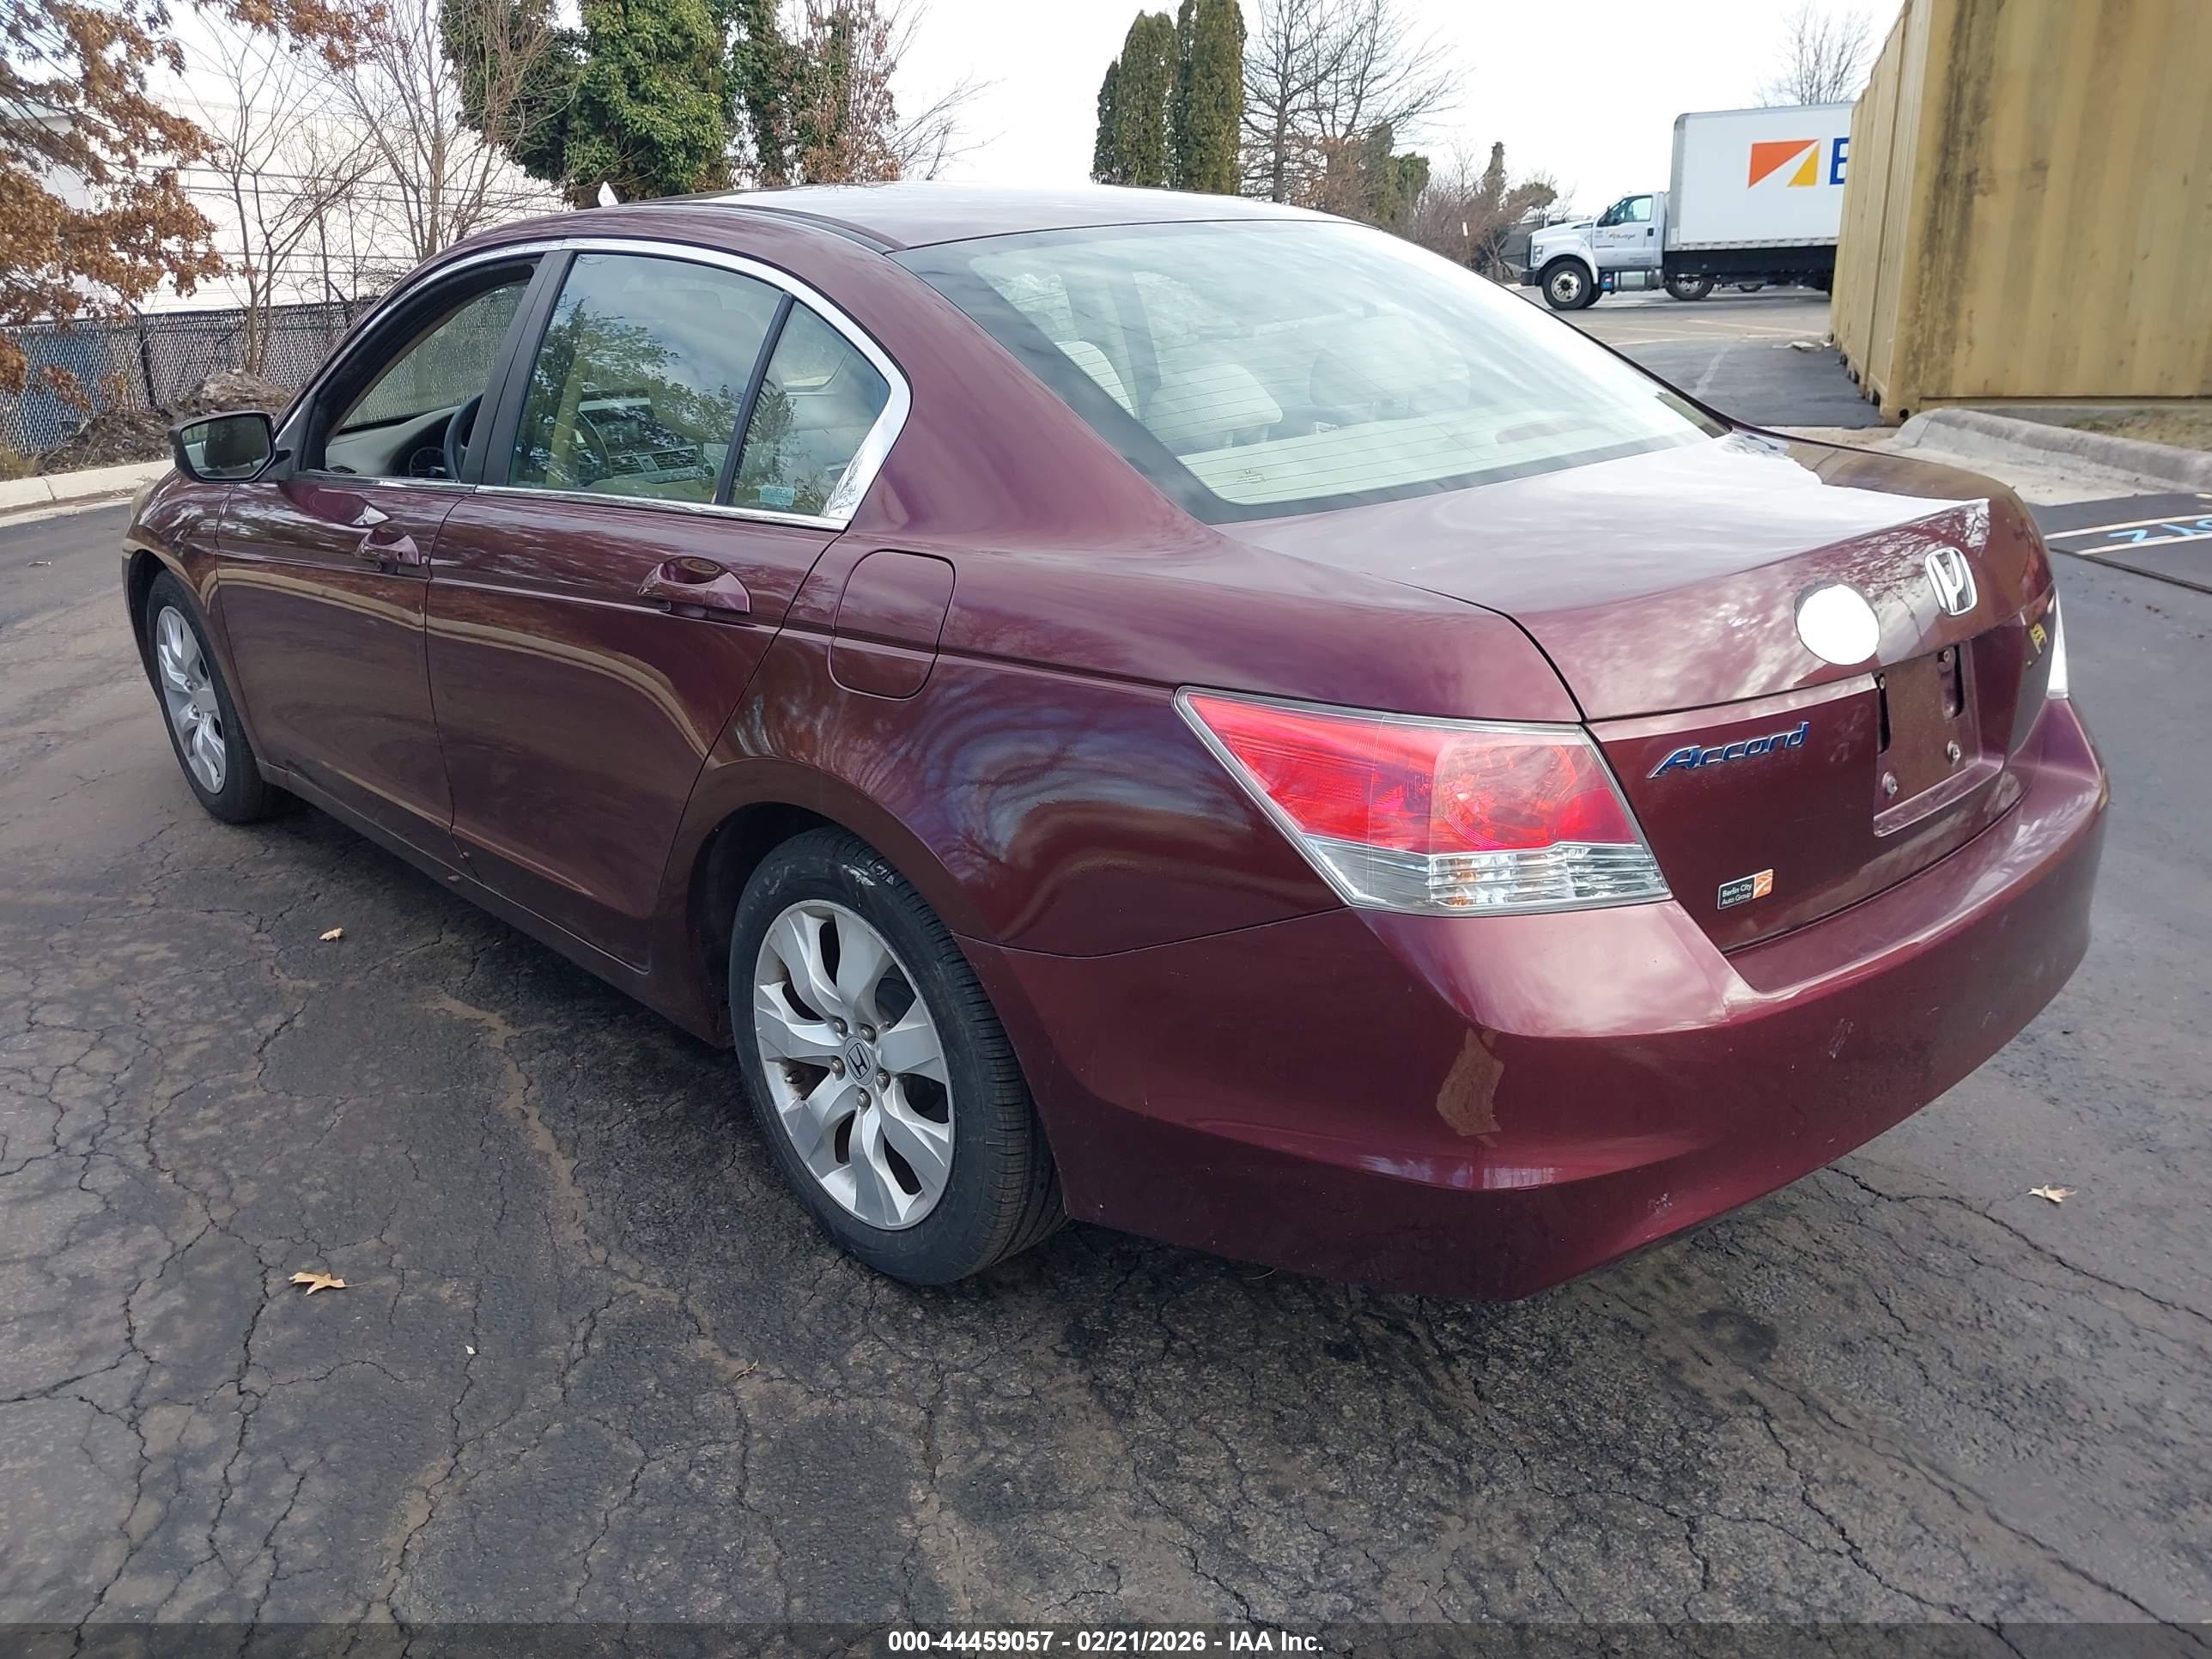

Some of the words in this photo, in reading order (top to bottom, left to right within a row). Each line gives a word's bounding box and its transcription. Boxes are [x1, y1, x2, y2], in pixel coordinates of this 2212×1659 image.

[1646, 721, 1809, 779] Accord
[1722, 887, 1740, 898] Berlin
[1740, 883, 1753, 892] City
[1721, 896, 1735, 906] Auto
[1735, 892, 1752, 902] Group
